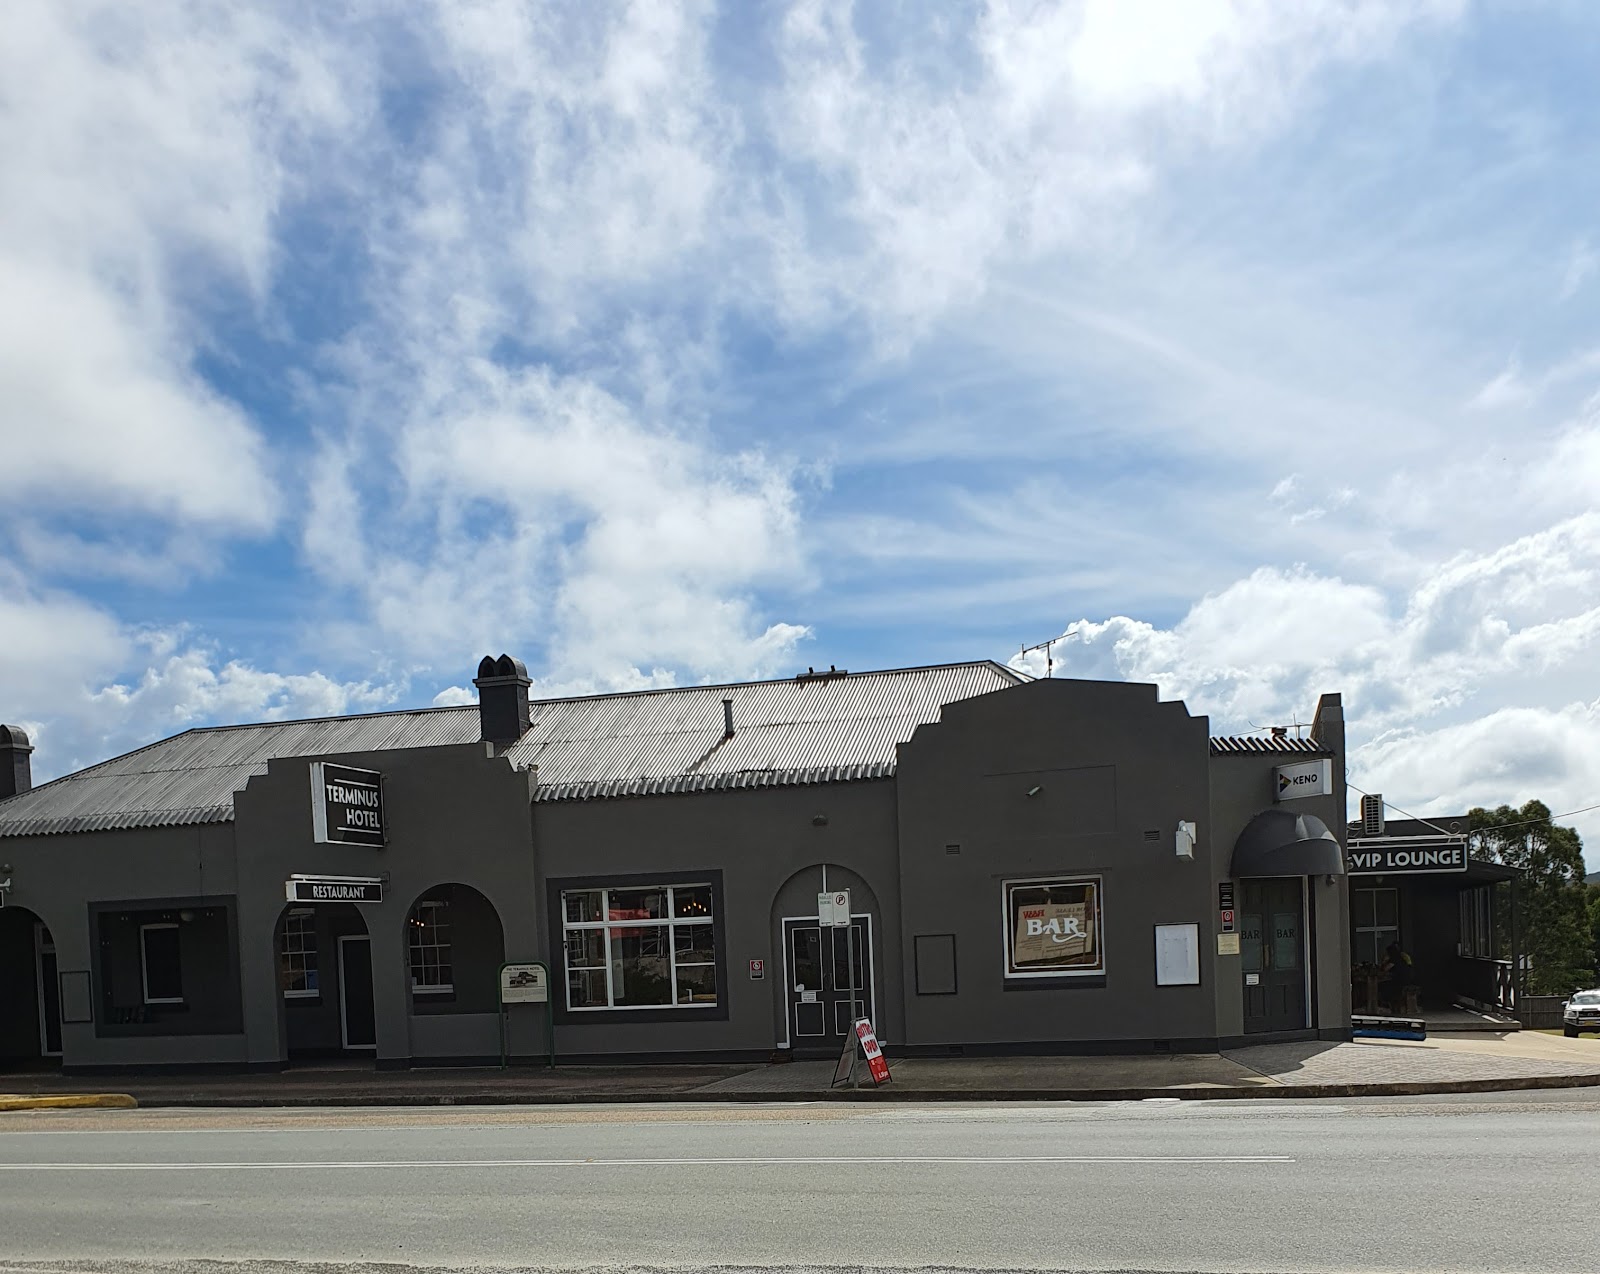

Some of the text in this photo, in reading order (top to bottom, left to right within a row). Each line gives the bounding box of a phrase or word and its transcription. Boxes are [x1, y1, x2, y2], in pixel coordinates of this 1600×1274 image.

[1292, 773, 1318, 786] KENO
[326, 784, 379, 808] TERMINUS
[346, 808, 380, 828] HOTEL
[1352, 850, 1461, 868] VIP LOUNGE
[312, 885, 365, 898] RESTAURANT
[1027, 918, 1087, 943] BAR
[1241, 930, 1260, 940] BAR
[1276, 929, 1295, 938] BAR
[864, 1039, 878, 1054] OPEN
